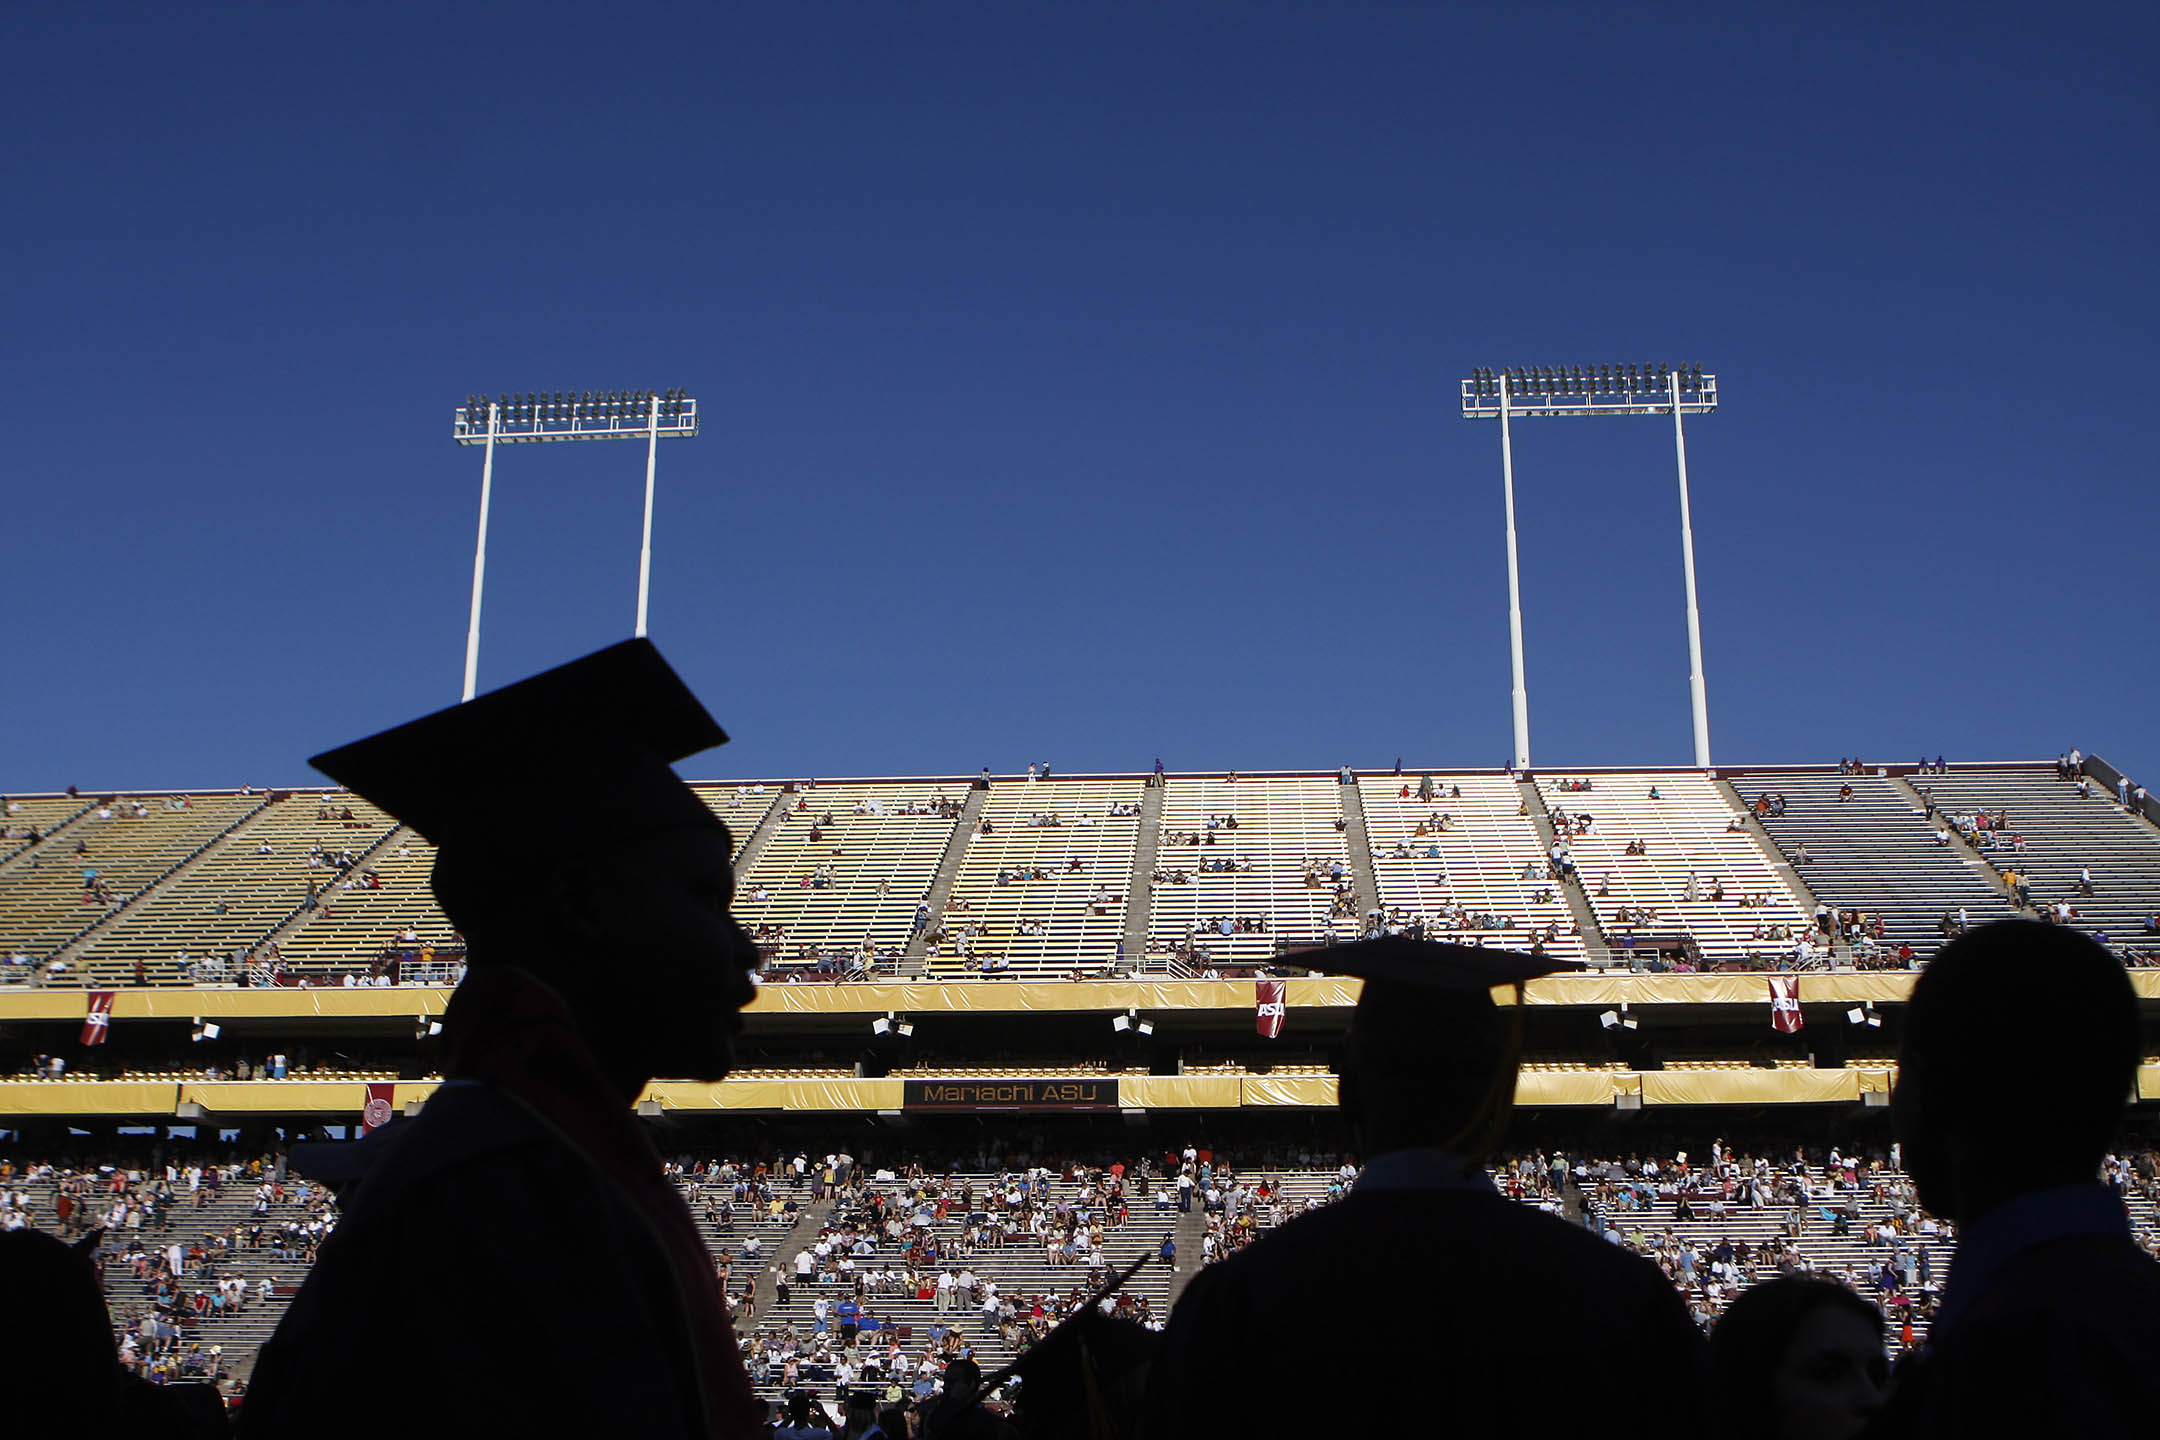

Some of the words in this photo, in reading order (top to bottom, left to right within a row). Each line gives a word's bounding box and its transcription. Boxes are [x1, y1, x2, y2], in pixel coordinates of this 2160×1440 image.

[1257, 1003, 1285, 1017] ASU
[924, 1085, 1034, 1101] Mariachi
[1041, 1084, 1096, 1101] ASU
